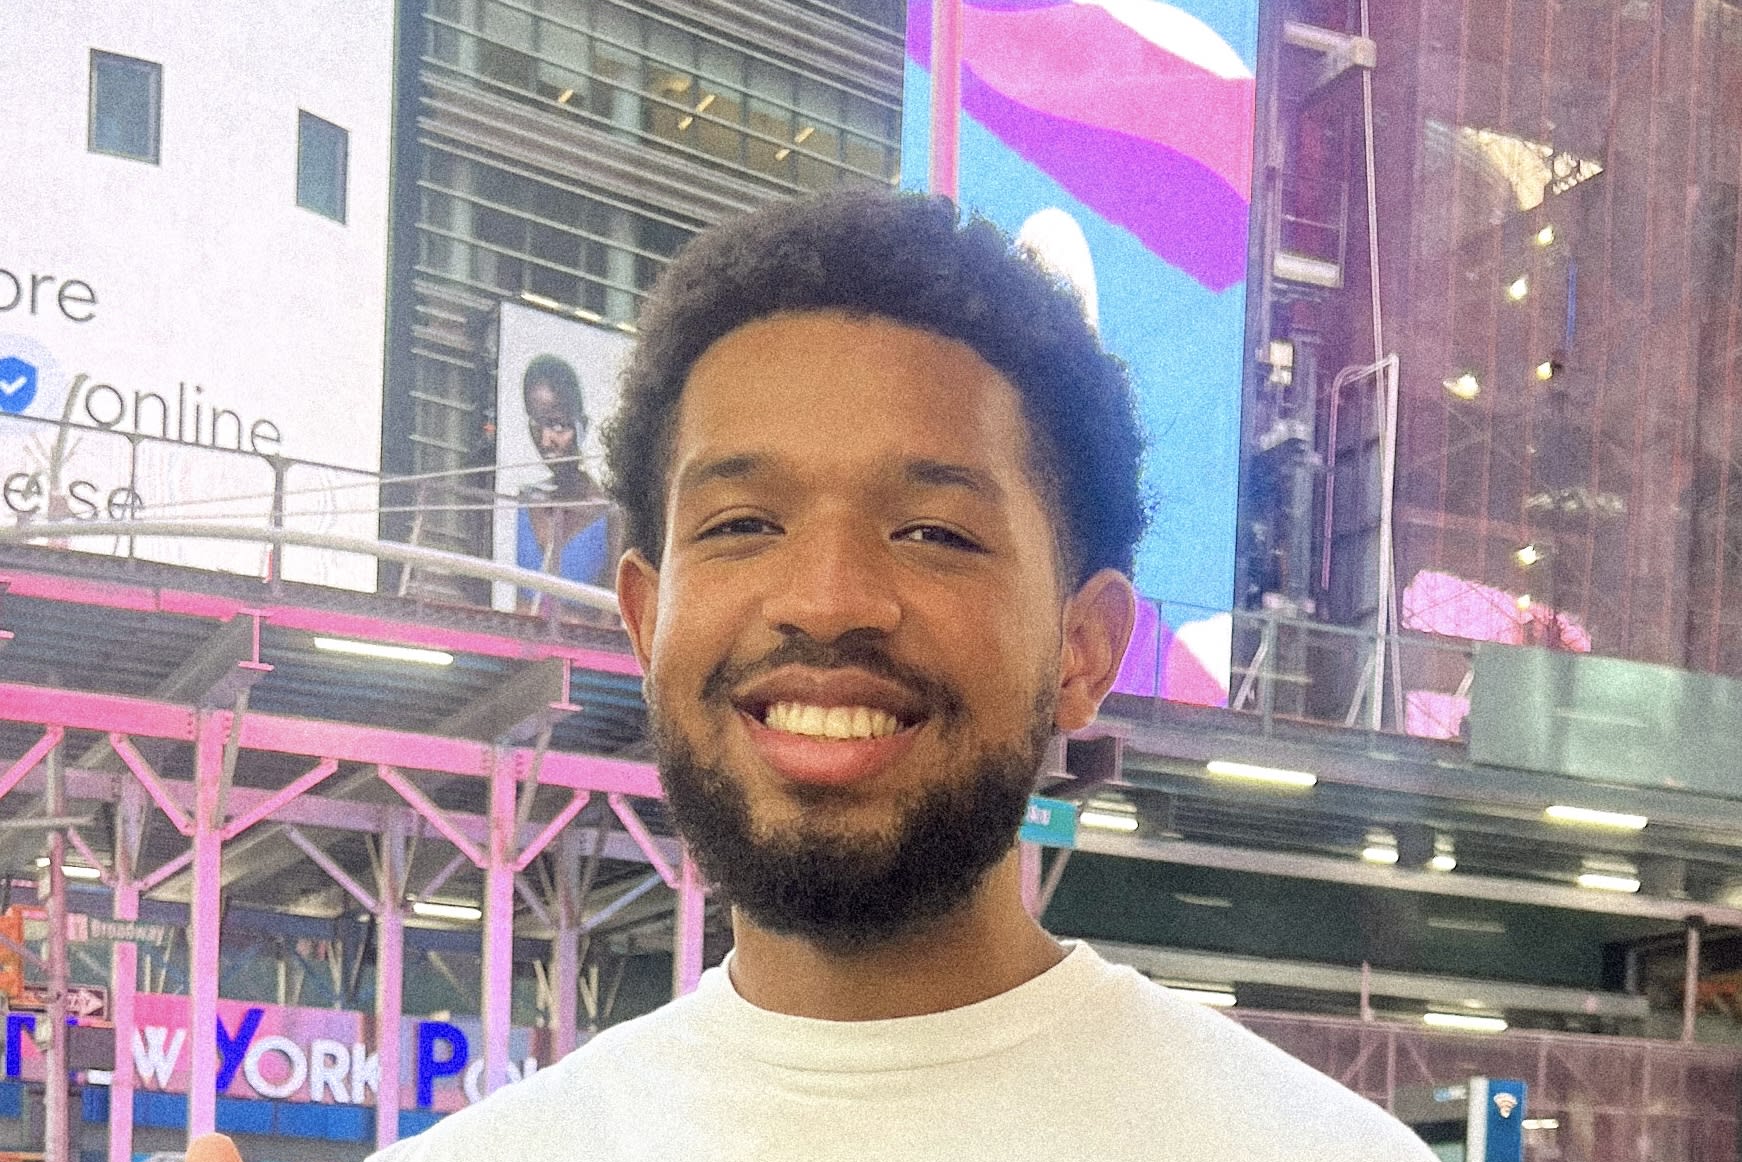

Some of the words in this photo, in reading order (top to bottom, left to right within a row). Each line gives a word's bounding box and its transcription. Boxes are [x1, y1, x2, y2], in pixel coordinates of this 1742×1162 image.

[85, 381, 282, 455] online
[3, 471, 144, 522] ese
[216, 1008, 379, 1105] YORK
